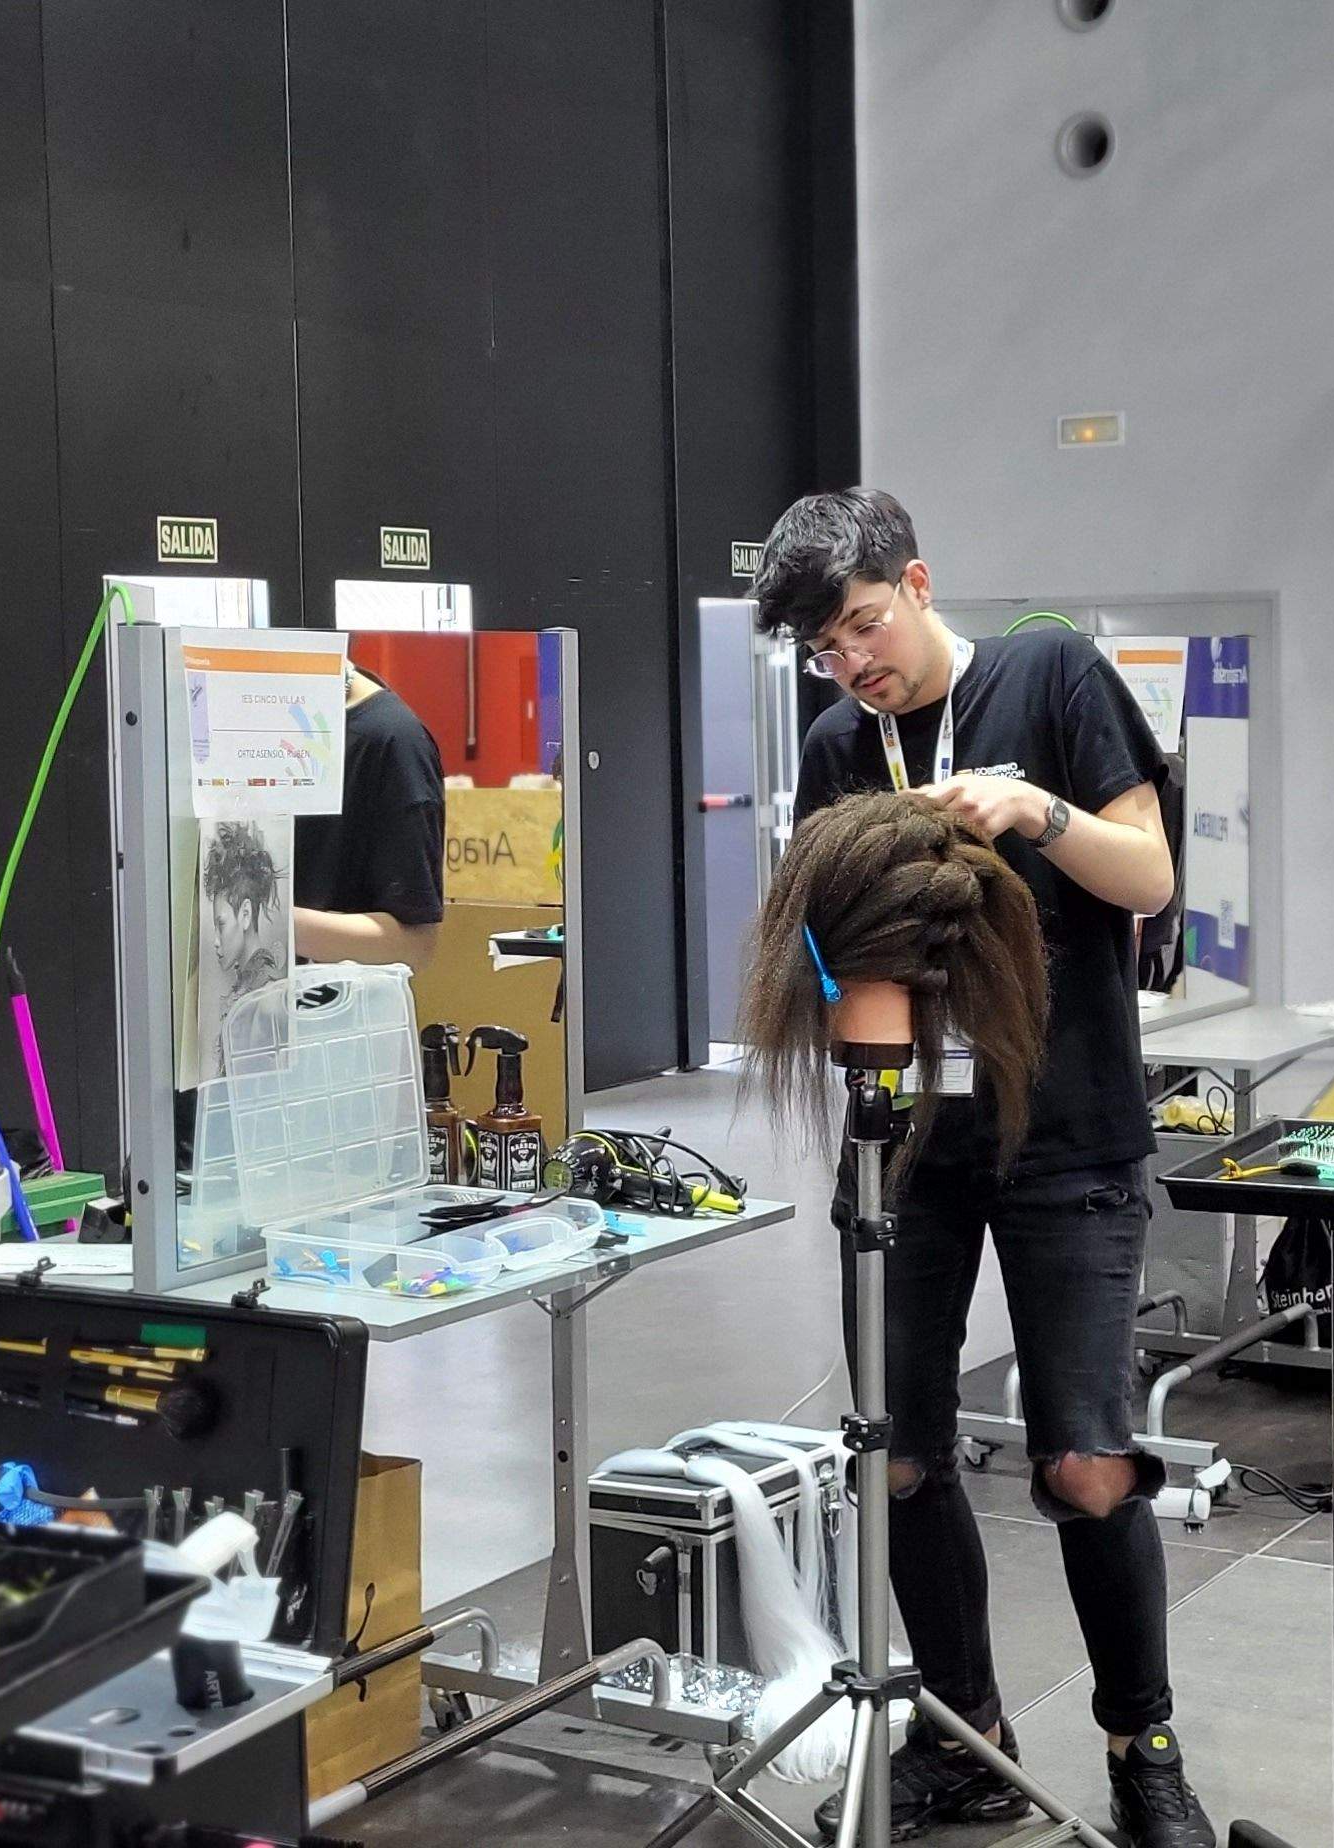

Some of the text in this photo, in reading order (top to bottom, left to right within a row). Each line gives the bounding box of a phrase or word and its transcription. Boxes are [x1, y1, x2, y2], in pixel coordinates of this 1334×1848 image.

[161, 525, 214, 555] SALIDA
[383, 534, 427, 562] SALIDA
[1271, 1284, 1334, 1309] Steinhar
